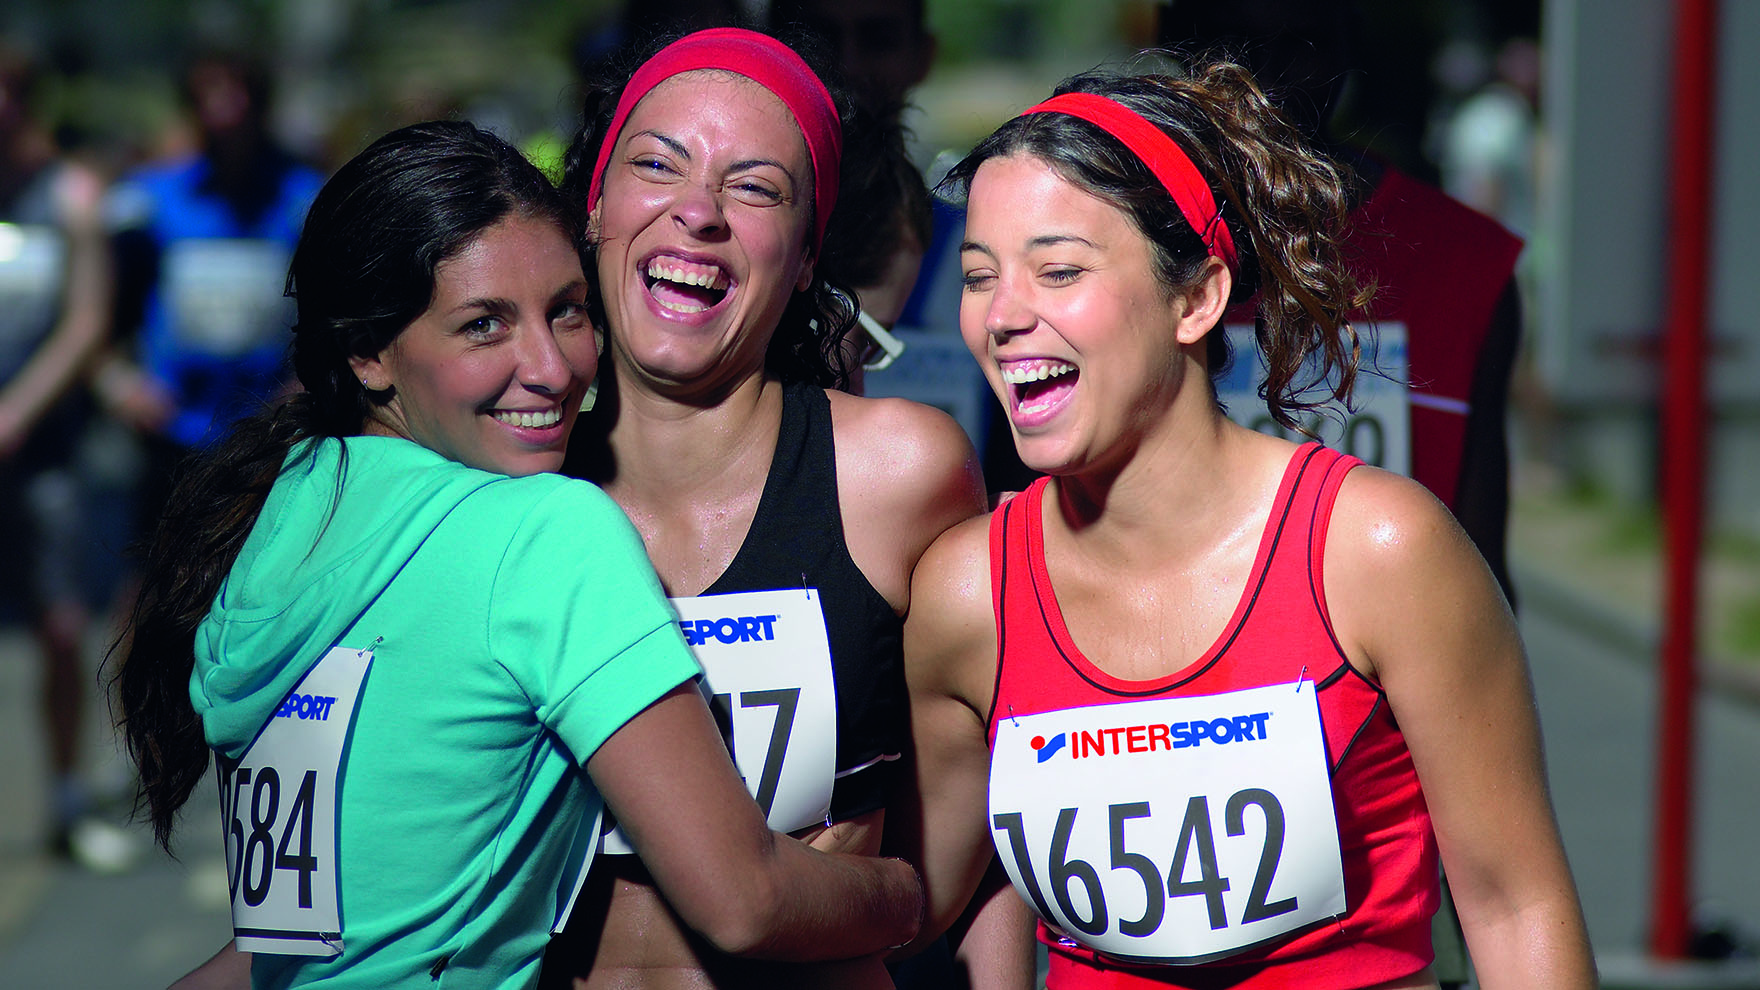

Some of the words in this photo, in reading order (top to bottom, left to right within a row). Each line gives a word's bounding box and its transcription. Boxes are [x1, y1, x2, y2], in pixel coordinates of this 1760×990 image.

[709, 687, 801, 824] 7
[1071, 712, 1271, 759] INTERSPORT
[993, 787, 1299, 938] 16542
